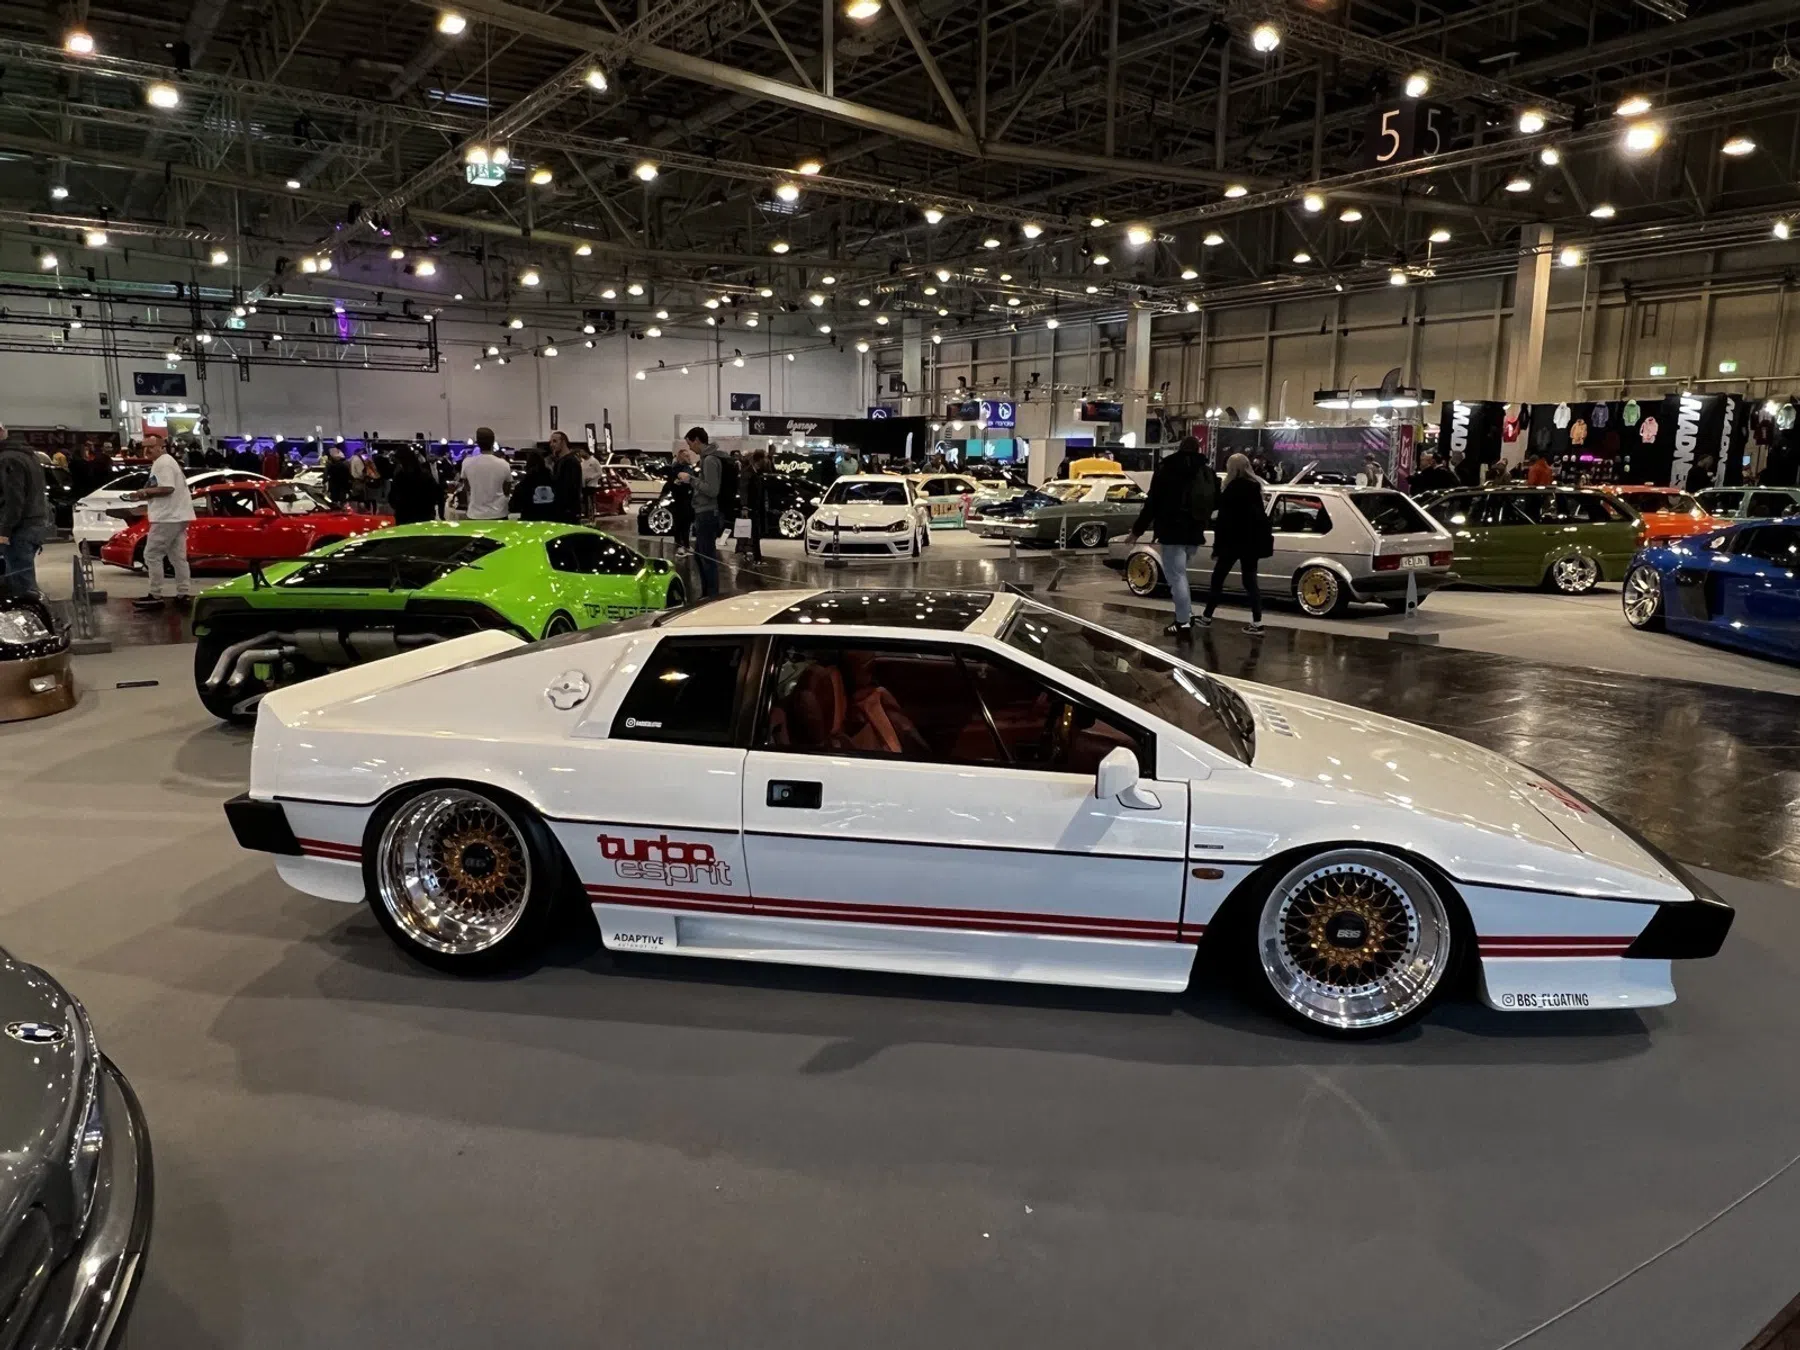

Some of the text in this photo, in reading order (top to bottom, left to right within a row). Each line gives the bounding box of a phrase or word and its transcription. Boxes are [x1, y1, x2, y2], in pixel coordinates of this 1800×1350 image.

[1376, 109, 1400, 162] 5
[1423, 108, 1441, 159] 5
[136, 374, 144, 385] 6
[597, 834, 715, 864] turbo
[615, 858, 732, 886] esprit
[613, 933, 664, 945] ADAPTIVE
[1337, 929, 1361, 938] BBS
